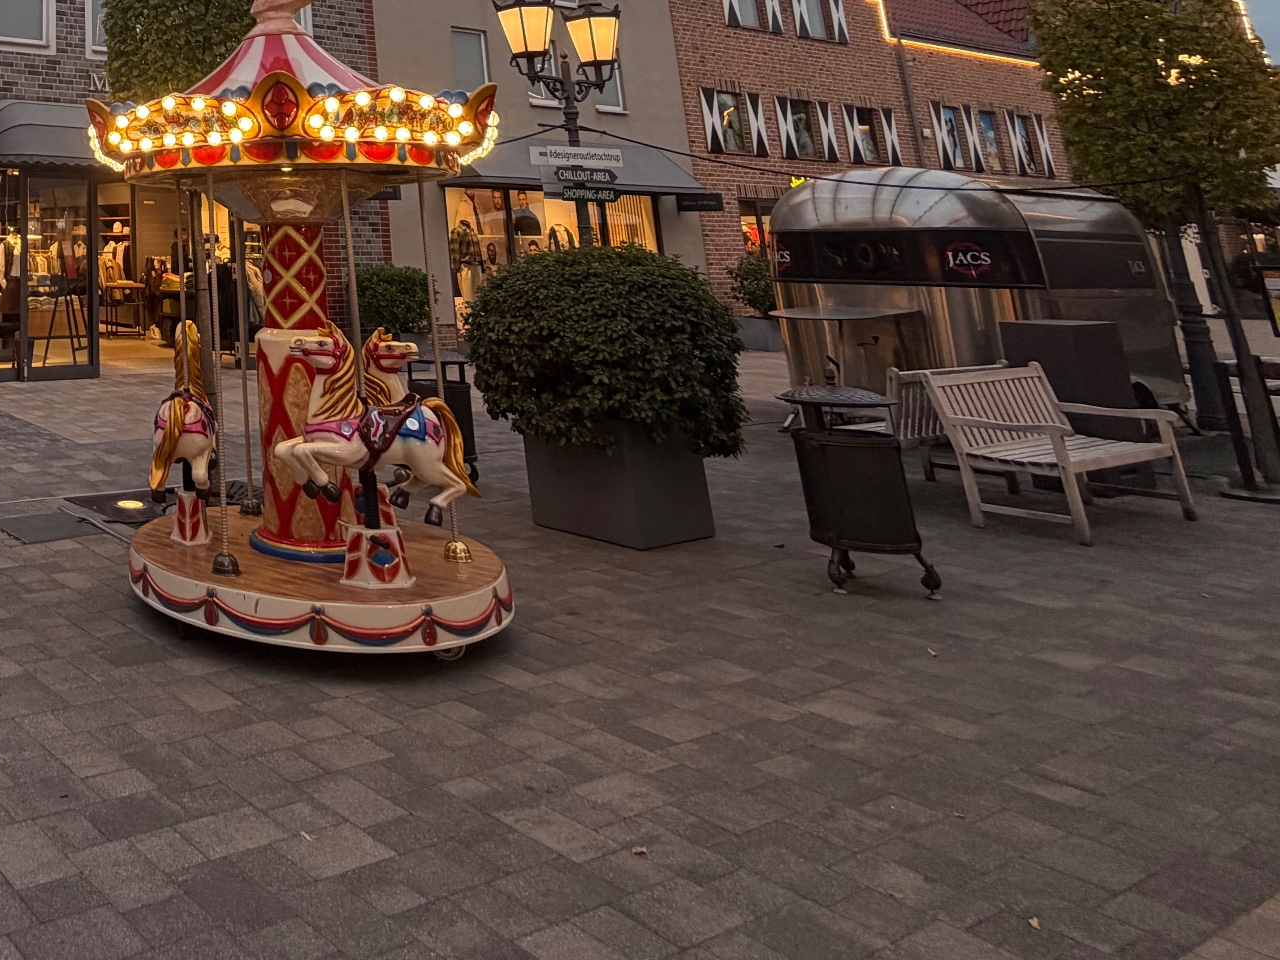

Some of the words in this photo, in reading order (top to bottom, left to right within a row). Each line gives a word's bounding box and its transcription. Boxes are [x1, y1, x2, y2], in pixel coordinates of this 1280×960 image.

[548, 149, 621, 163] #designeroutletochtrup
[558, 169, 611, 182] CHILLOUT-AREA
[563, 188, 615, 200] SHOPPING-AREA
[947, 251, 991, 268] JACS
